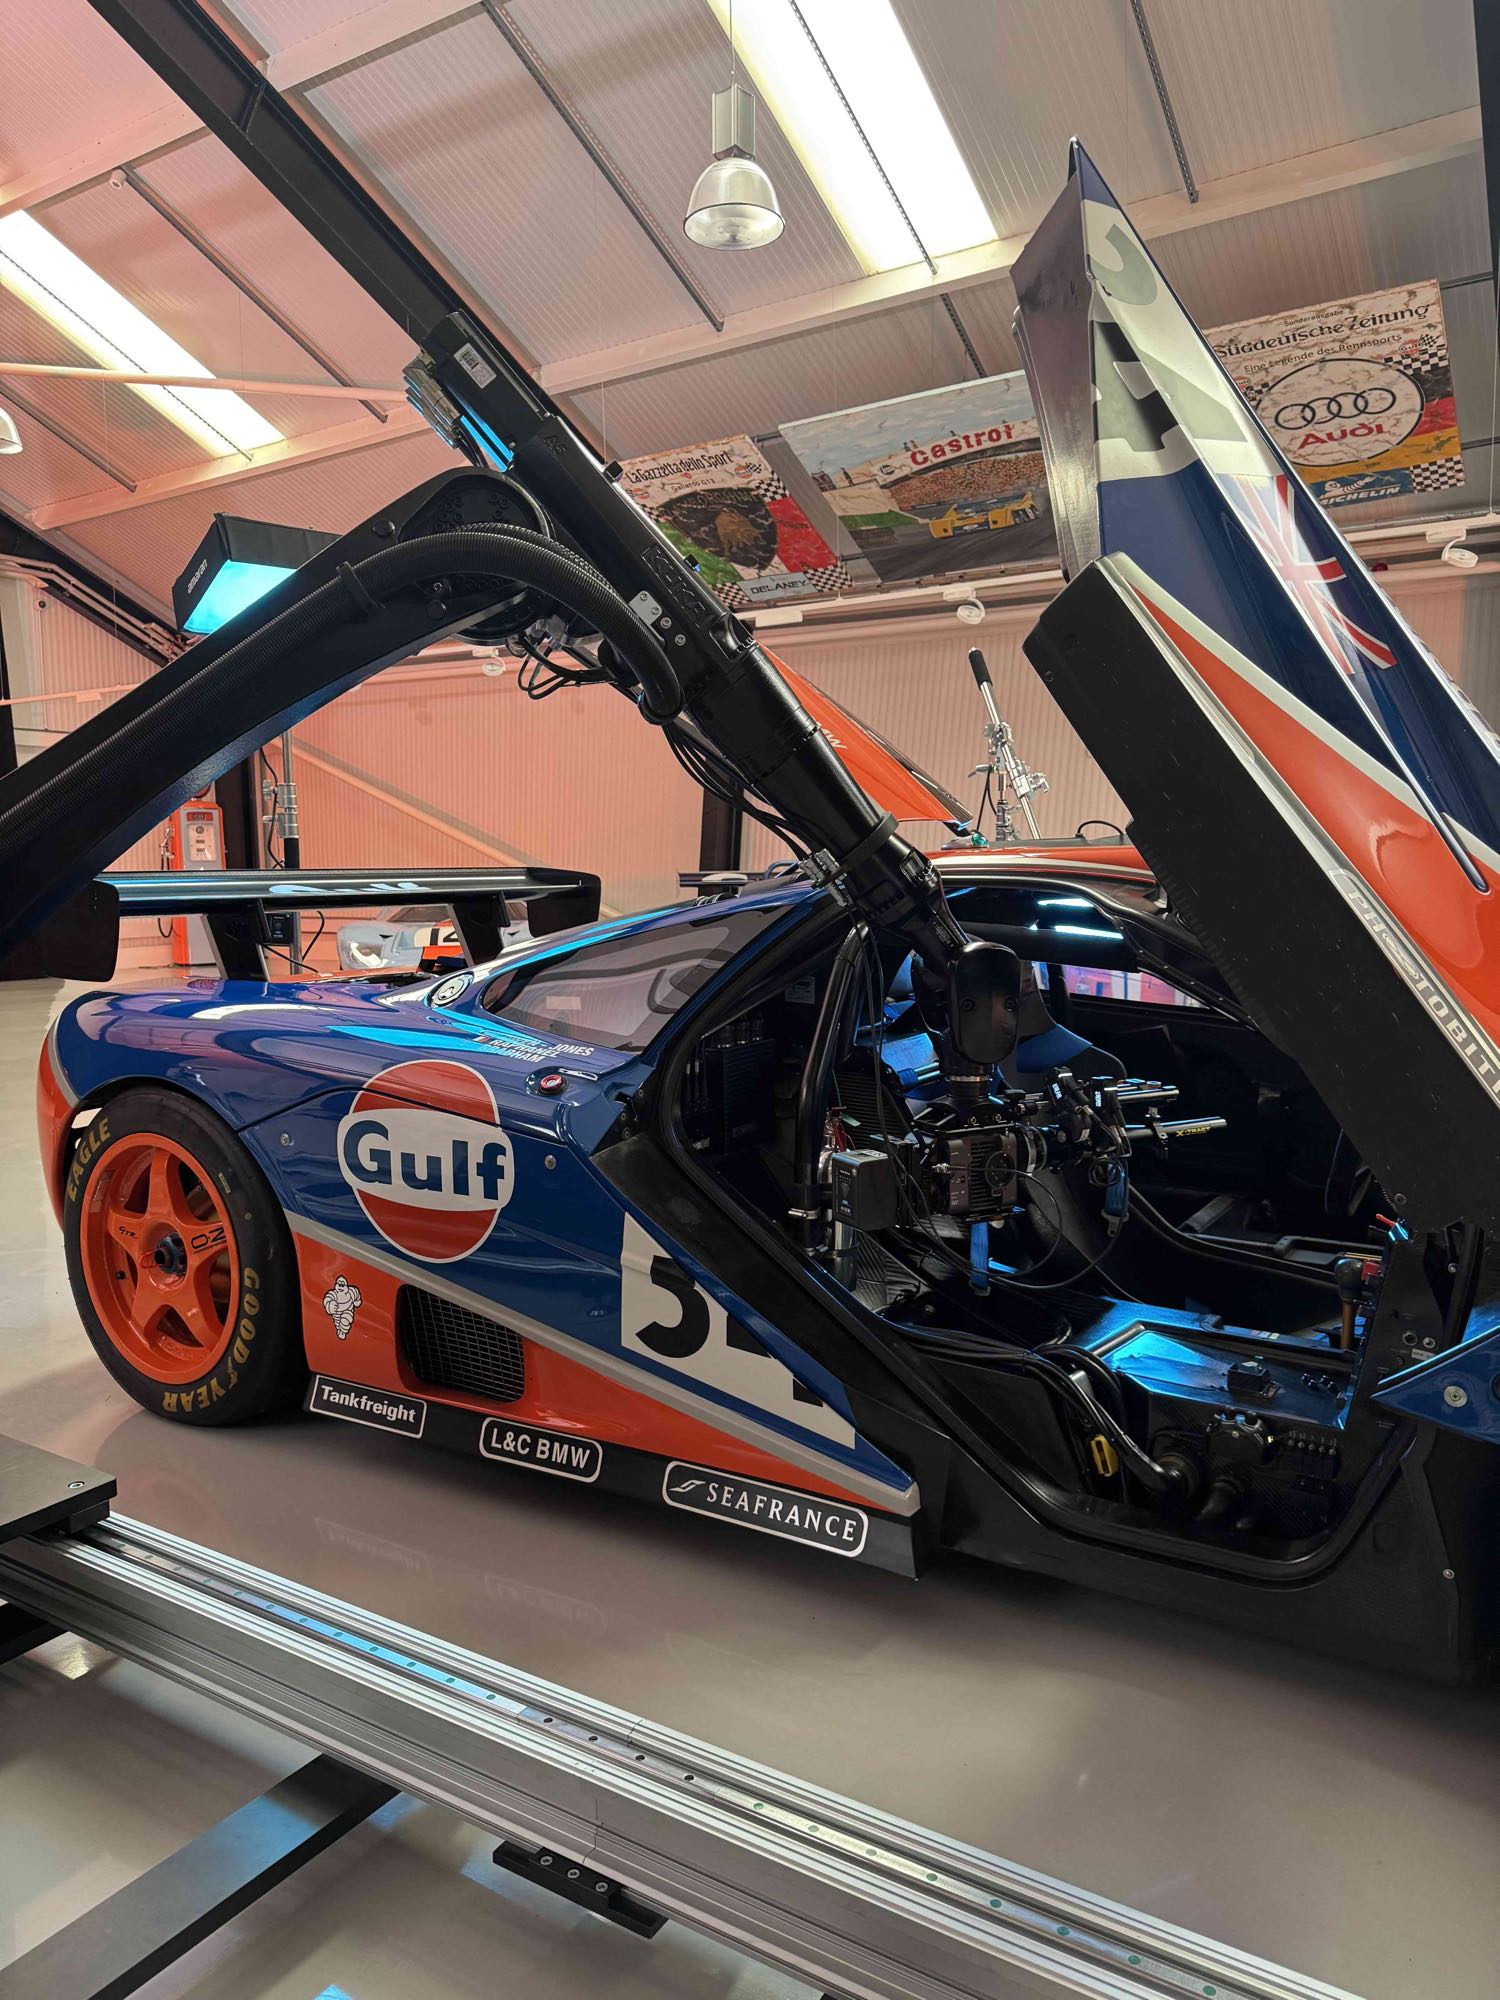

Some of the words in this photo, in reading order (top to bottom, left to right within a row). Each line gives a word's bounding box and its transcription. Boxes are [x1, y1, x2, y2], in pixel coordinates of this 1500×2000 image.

[1346, 303, 1430, 334] Zeitung
[1244, 361, 1268, 374] Eine
[1269, 350, 1315, 368] Legende
[1317, 345, 1336, 357] des
[1338, 333, 1403, 353] Rennsports
[639, 460, 684, 480] Gazzetta
[702, 450, 735, 468] Sport
[751, 579, 807, 595] DELANEY
[549, 1043, 595, 1057] JONES
[67, 1117, 111, 1202] EAGLE
[343, 1119, 507, 1201] Gulf
[321, 1385, 416, 1423] Tankfreight
[491, 1427, 532, 1455] L&C
[535, 1438, 591, 1469] BMW
[706, 1482, 858, 1542] SEAFRANCE
